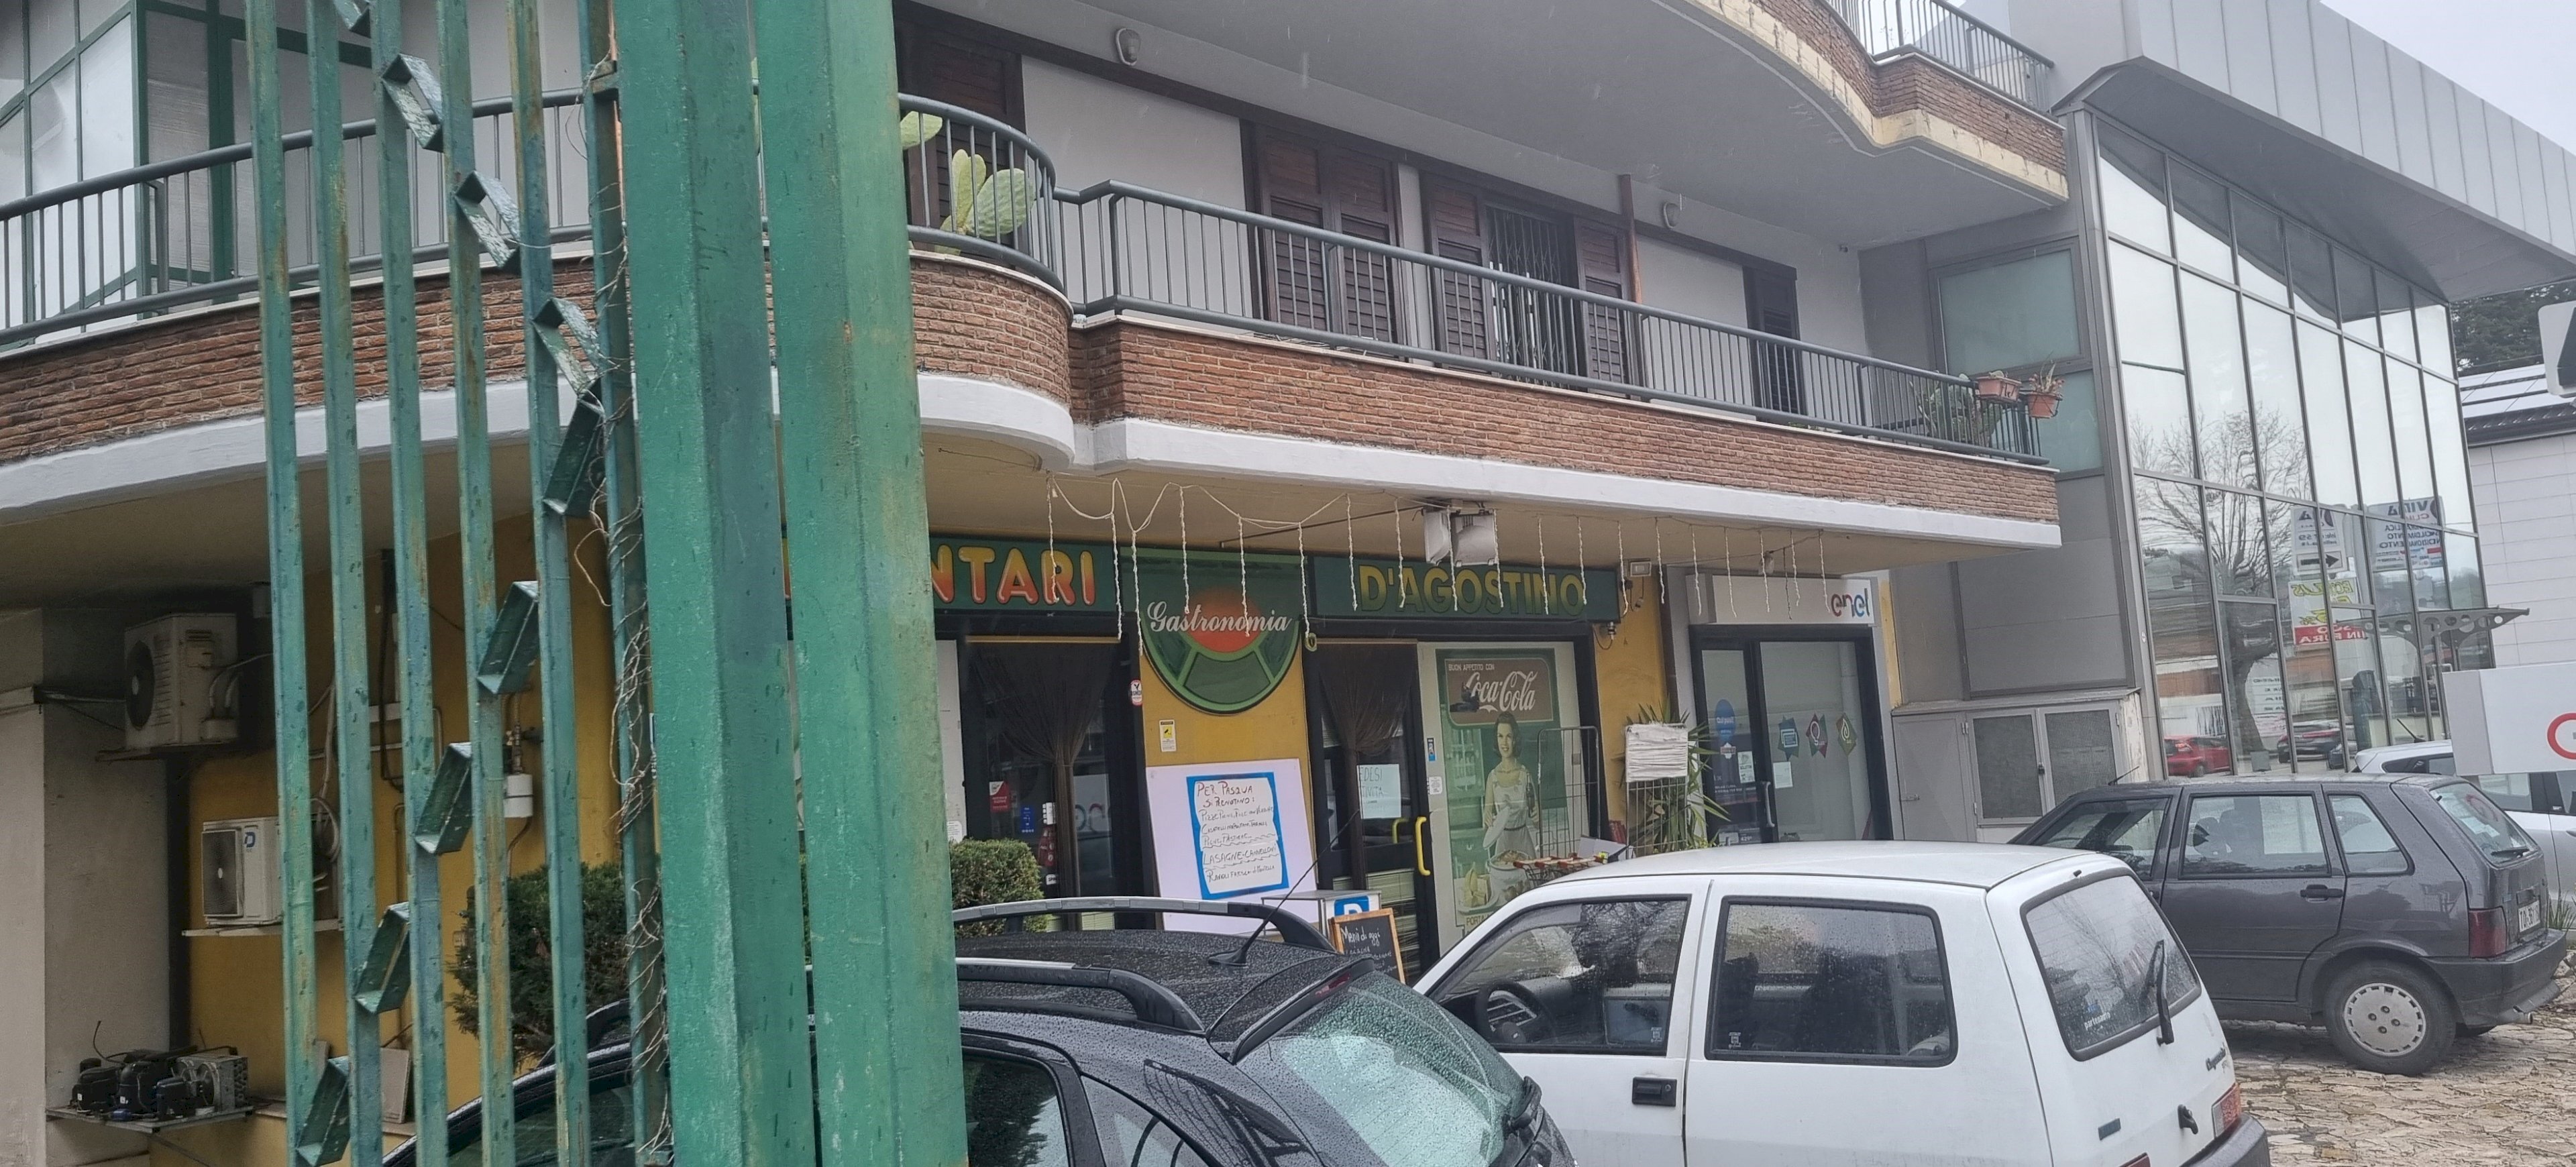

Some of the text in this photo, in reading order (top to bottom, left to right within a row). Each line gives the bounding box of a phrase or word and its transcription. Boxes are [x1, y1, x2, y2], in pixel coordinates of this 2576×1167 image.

[930, 545, 1095, 606] NTARI
[1358, 564, 1585, 616] D'AGOSTINO
[1146, 600, 1292, 632] Gastronomia
[1831, 588, 1870, 618] enel
[1465, 671, 1538, 713] Coca-Cola
[1218, 781, 1253, 795] PASQUA
[1360, 767, 1383, 782] EDESI
